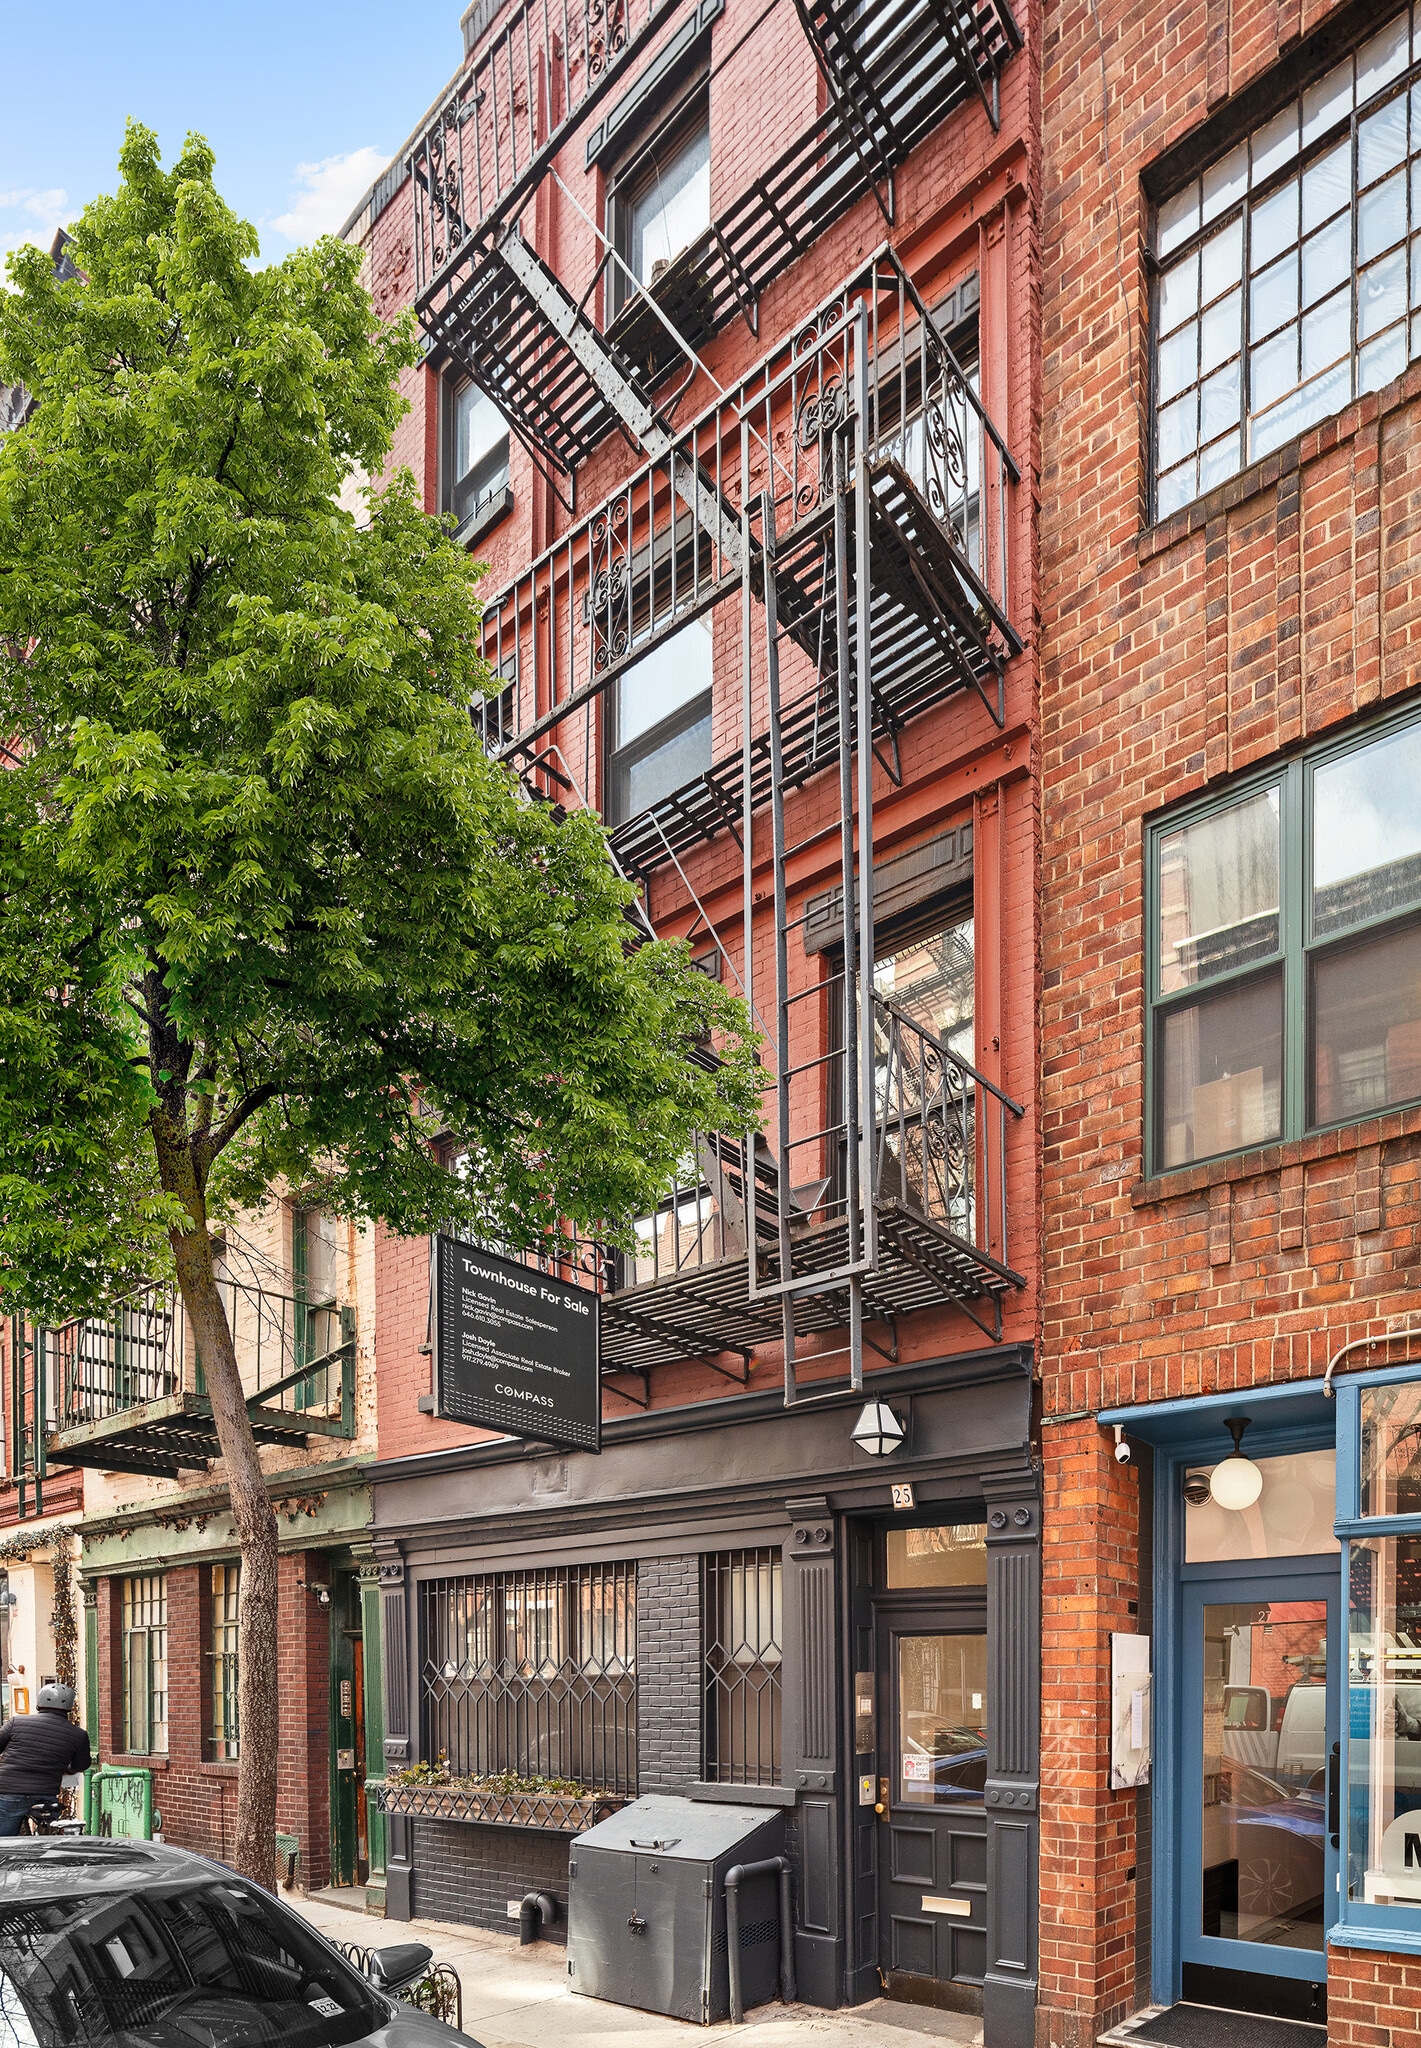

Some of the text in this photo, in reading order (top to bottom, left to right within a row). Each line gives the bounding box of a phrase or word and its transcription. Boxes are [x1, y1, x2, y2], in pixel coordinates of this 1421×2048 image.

[461, 1287, 497, 1304] Nick Gavin
[462, 1258, 590, 1316] Townhouse For Sale
[461, 1295, 558, 1333] Licensed Real Estate Salesperson
[461, 1331, 496, 1347] Josh Doyle
[461, 1339, 571, 1377] Licensed Associate Real Estate Broker
[494, 1383, 554, 1408] COMPASS
[893, 1488, 911, 1504] 25
